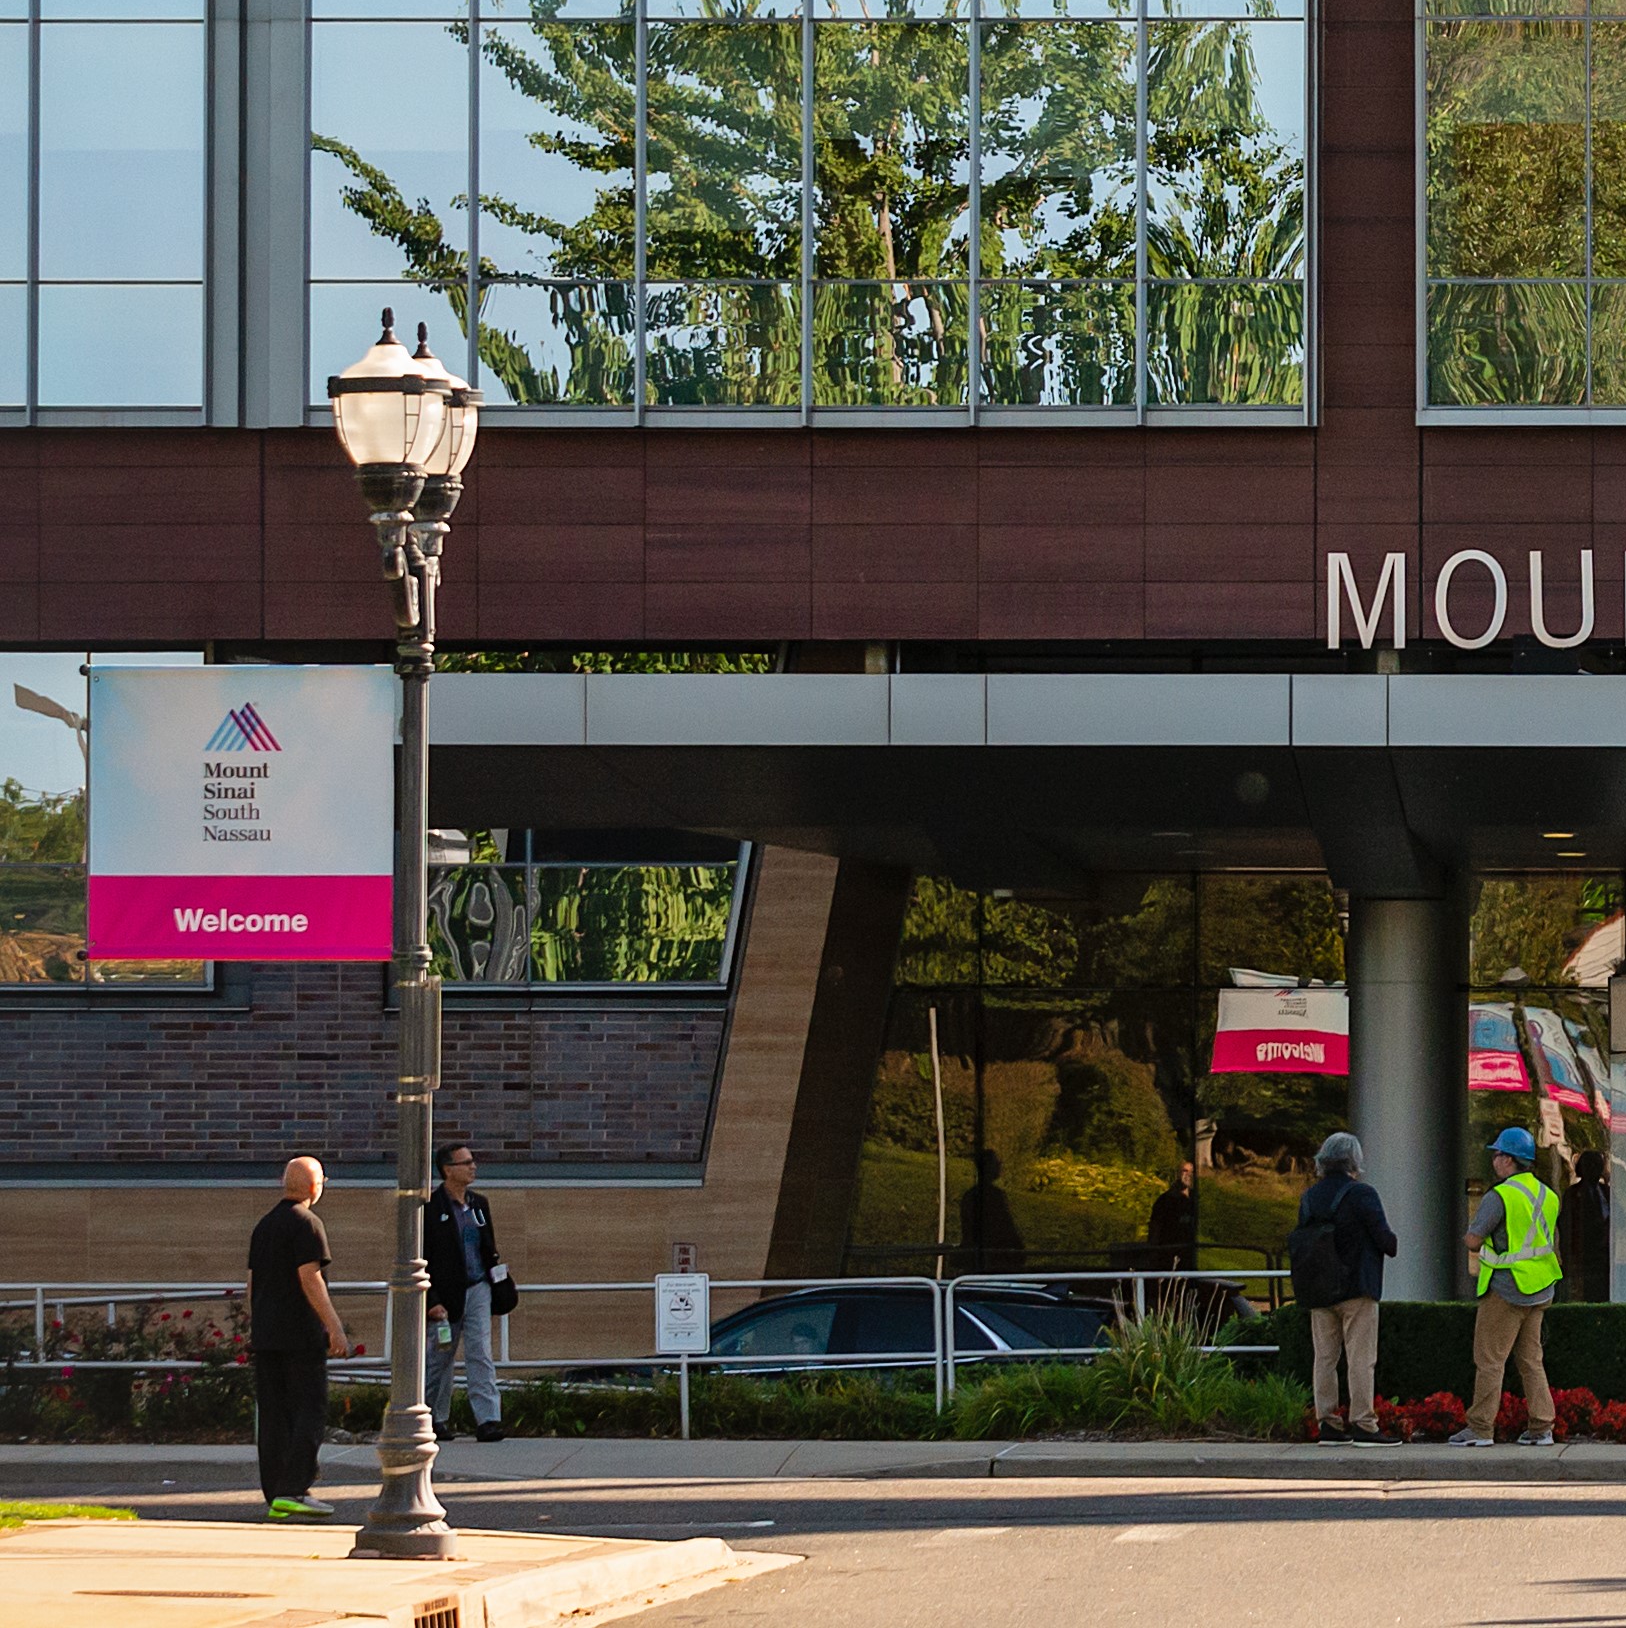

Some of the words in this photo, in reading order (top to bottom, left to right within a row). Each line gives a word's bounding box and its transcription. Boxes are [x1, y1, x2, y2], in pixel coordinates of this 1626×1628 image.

[203, 762, 270, 779] Mount
[203, 782, 256, 800] Sinai
[203, 802, 261, 821] South
[202, 825, 272, 842] Nassau
[173, 908, 309, 933] Welcome
